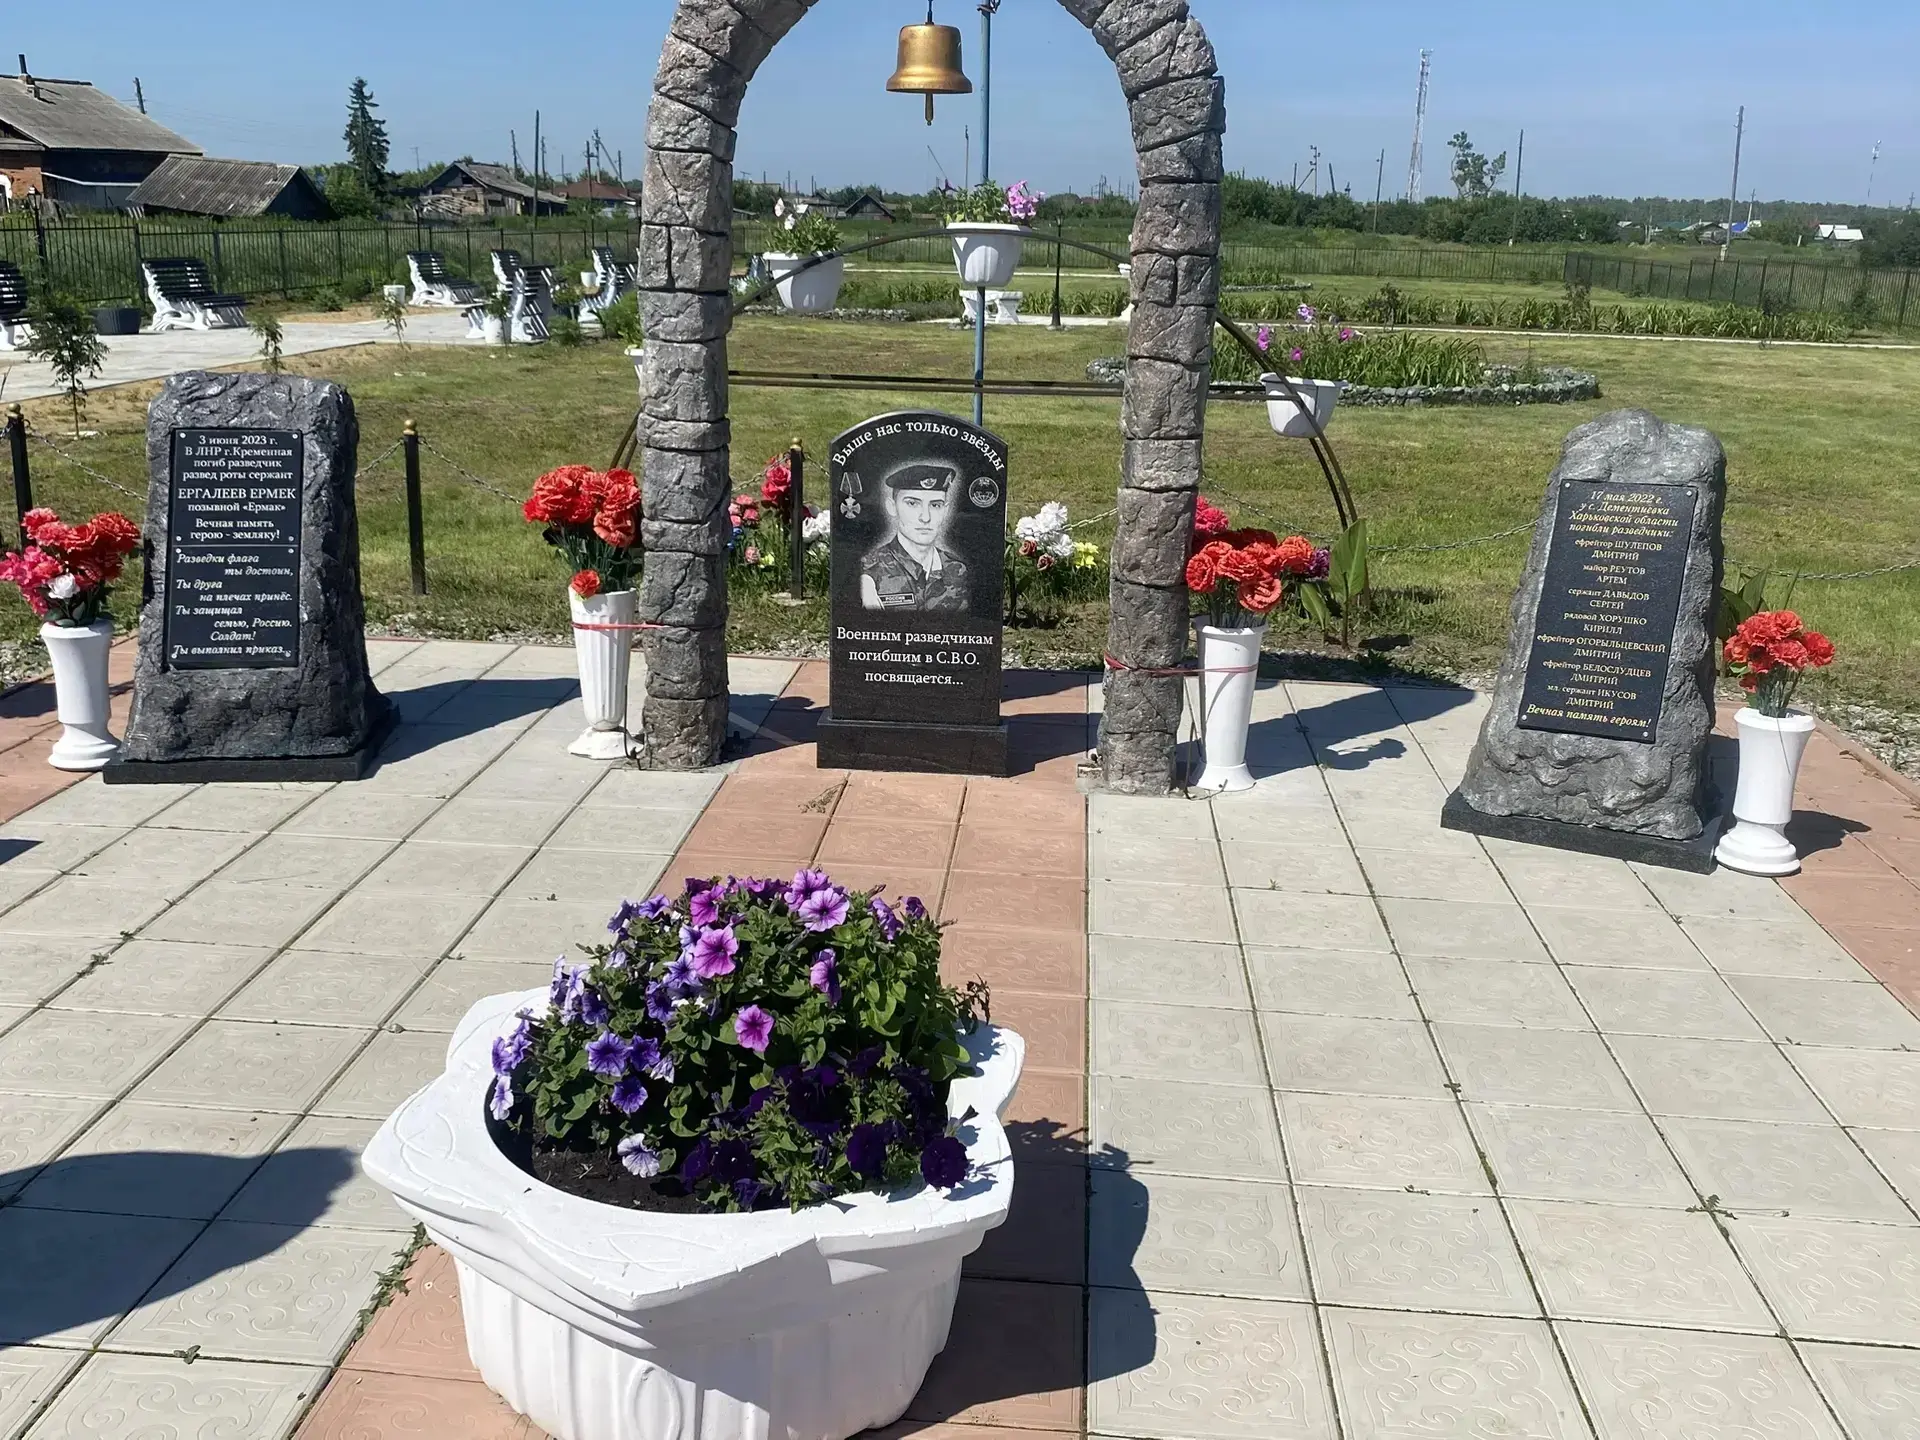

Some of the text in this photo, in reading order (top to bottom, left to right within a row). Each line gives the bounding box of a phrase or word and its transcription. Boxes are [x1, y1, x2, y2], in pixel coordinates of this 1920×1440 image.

[199, 435, 278, 445] 3 июня 2023 г.
[185, 447, 293, 458] В ЛНР г.Кременная
[831, 421, 1005, 472] Выше нас только звёзды
[194, 458, 282, 470] погиб разведчик
[182, 471, 293, 481] развед роты сержант
[178, 488, 296, 499] ЕРГАЛЕЕВ ЕРМЕК
[1590, 490, 1663, 504] 17 мая 2022 г.
[188, 502, 286, 514] позывной «Ермак»
[1579, 502, 1587, 511] у
[1588, 503, 1596, 511] с.
[196, 518, 274, 528] Вечная память
[1569, 510, 1679, 527] Харьковской области
[190, 531, 223, 542] герою
[233, 530, 280, 541] земляку!
[1569, 523, 1674, 538] погибли разведчики:
[1574, 538, 1662, 551] ефрейтор ШУЛЕПОВ
[177, 553, 259, 565] Разведки флага
[1592, 550, 1640, 561] ДМИТРИЙ
[224, 566, 294, 576] ты достоин,
[1583, 564, 1646, 575] майор РЕУТОВ
[176, 579, 223, 590] Ты друга
[1596, 575, 1628, 585] АРТЕМ
[216, 593, 252, 601] плечах
[254, 591, 293, 602] принёс.
[1568, 588, 1650, 601] сержант ДАВЫДОВ
[175, 605, 243, 616] Ты защищал
[1589, 599, 1625, 610] СЕРГЕЙ
[213, 618, 293, 628] семью, Россию.
[1563, 612, 1648, 626] рядовой ХОРУШКО
[836, 626, 994, 645] Военным разведчикам
[1583, 624, 1623, 635] КИРИЛЛ
[210, 631, 257, 641] Солдат!
[1536, 633, 1666, 653] ефрейтор ОГОРЫЛЬЦЕВСКИЙ
[173, 645, 188, 655] Ты
[191, 646, 243, 654] выполнил
[1573, 648, 1622, 660] ДМИТРИЙ
[849, 649, 980, 666] погибшим в С.В.О.
[1542, 660, 1652, 678] ефрейтор БЕЛОСЛУДЦЕВ
[865, 671, 964, 685] посвящается...
[1570, 673, 1619, 685] ДМИТРИЙ
[1562, 686, 1597, 697] сержант
[1597, 689, 1637, 700] ИКУСОВ
[1566, 696, 1615, 709] ДМИТРИЙ
[1526, 704, 1651, 728] Вечная память героям!
